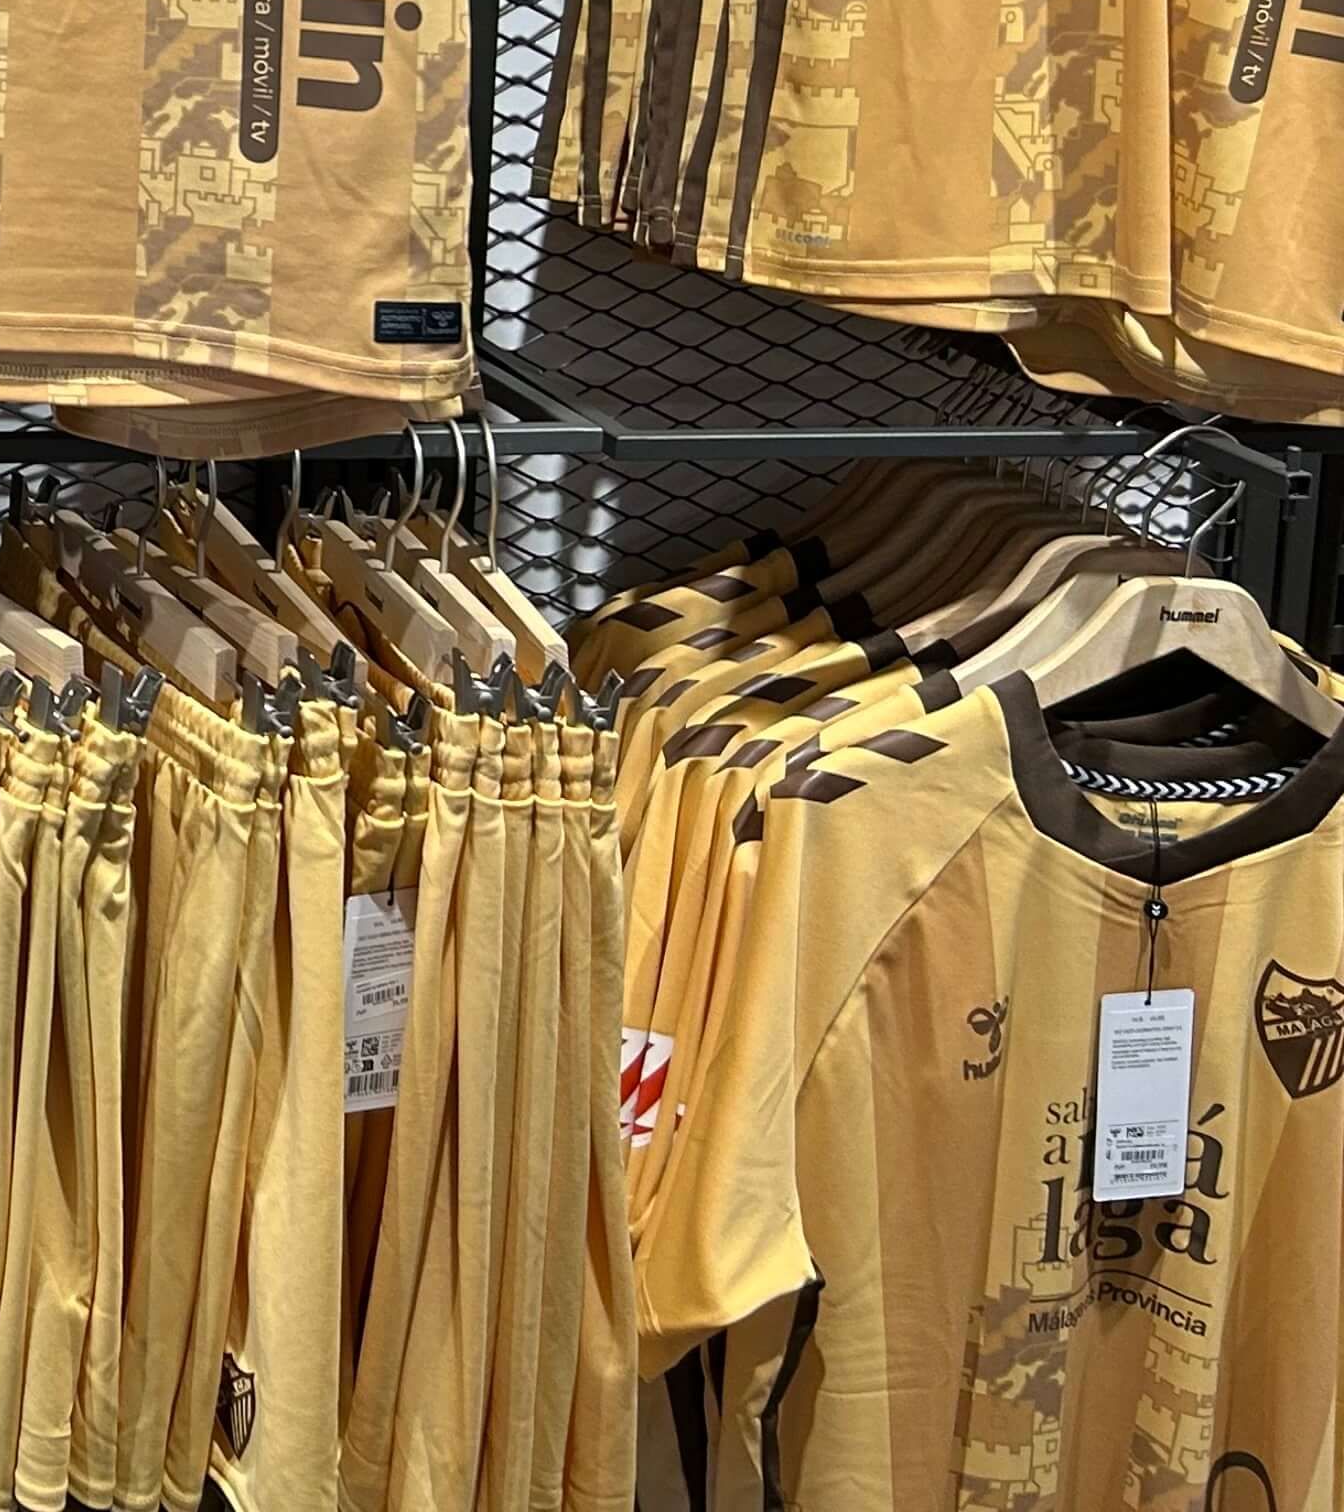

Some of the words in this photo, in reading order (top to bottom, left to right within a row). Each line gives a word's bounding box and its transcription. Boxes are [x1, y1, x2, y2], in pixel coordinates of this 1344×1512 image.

[251, 36, 277, 104] móvil
[1242, 63, 1262, 87] tv
[249, 121, 270, 145] tv
[1159, 606, 1221, 624] hummel
[1042, 1133, 1070, 1166] a
[1097, 1281, 1208, 1337] Provincia
